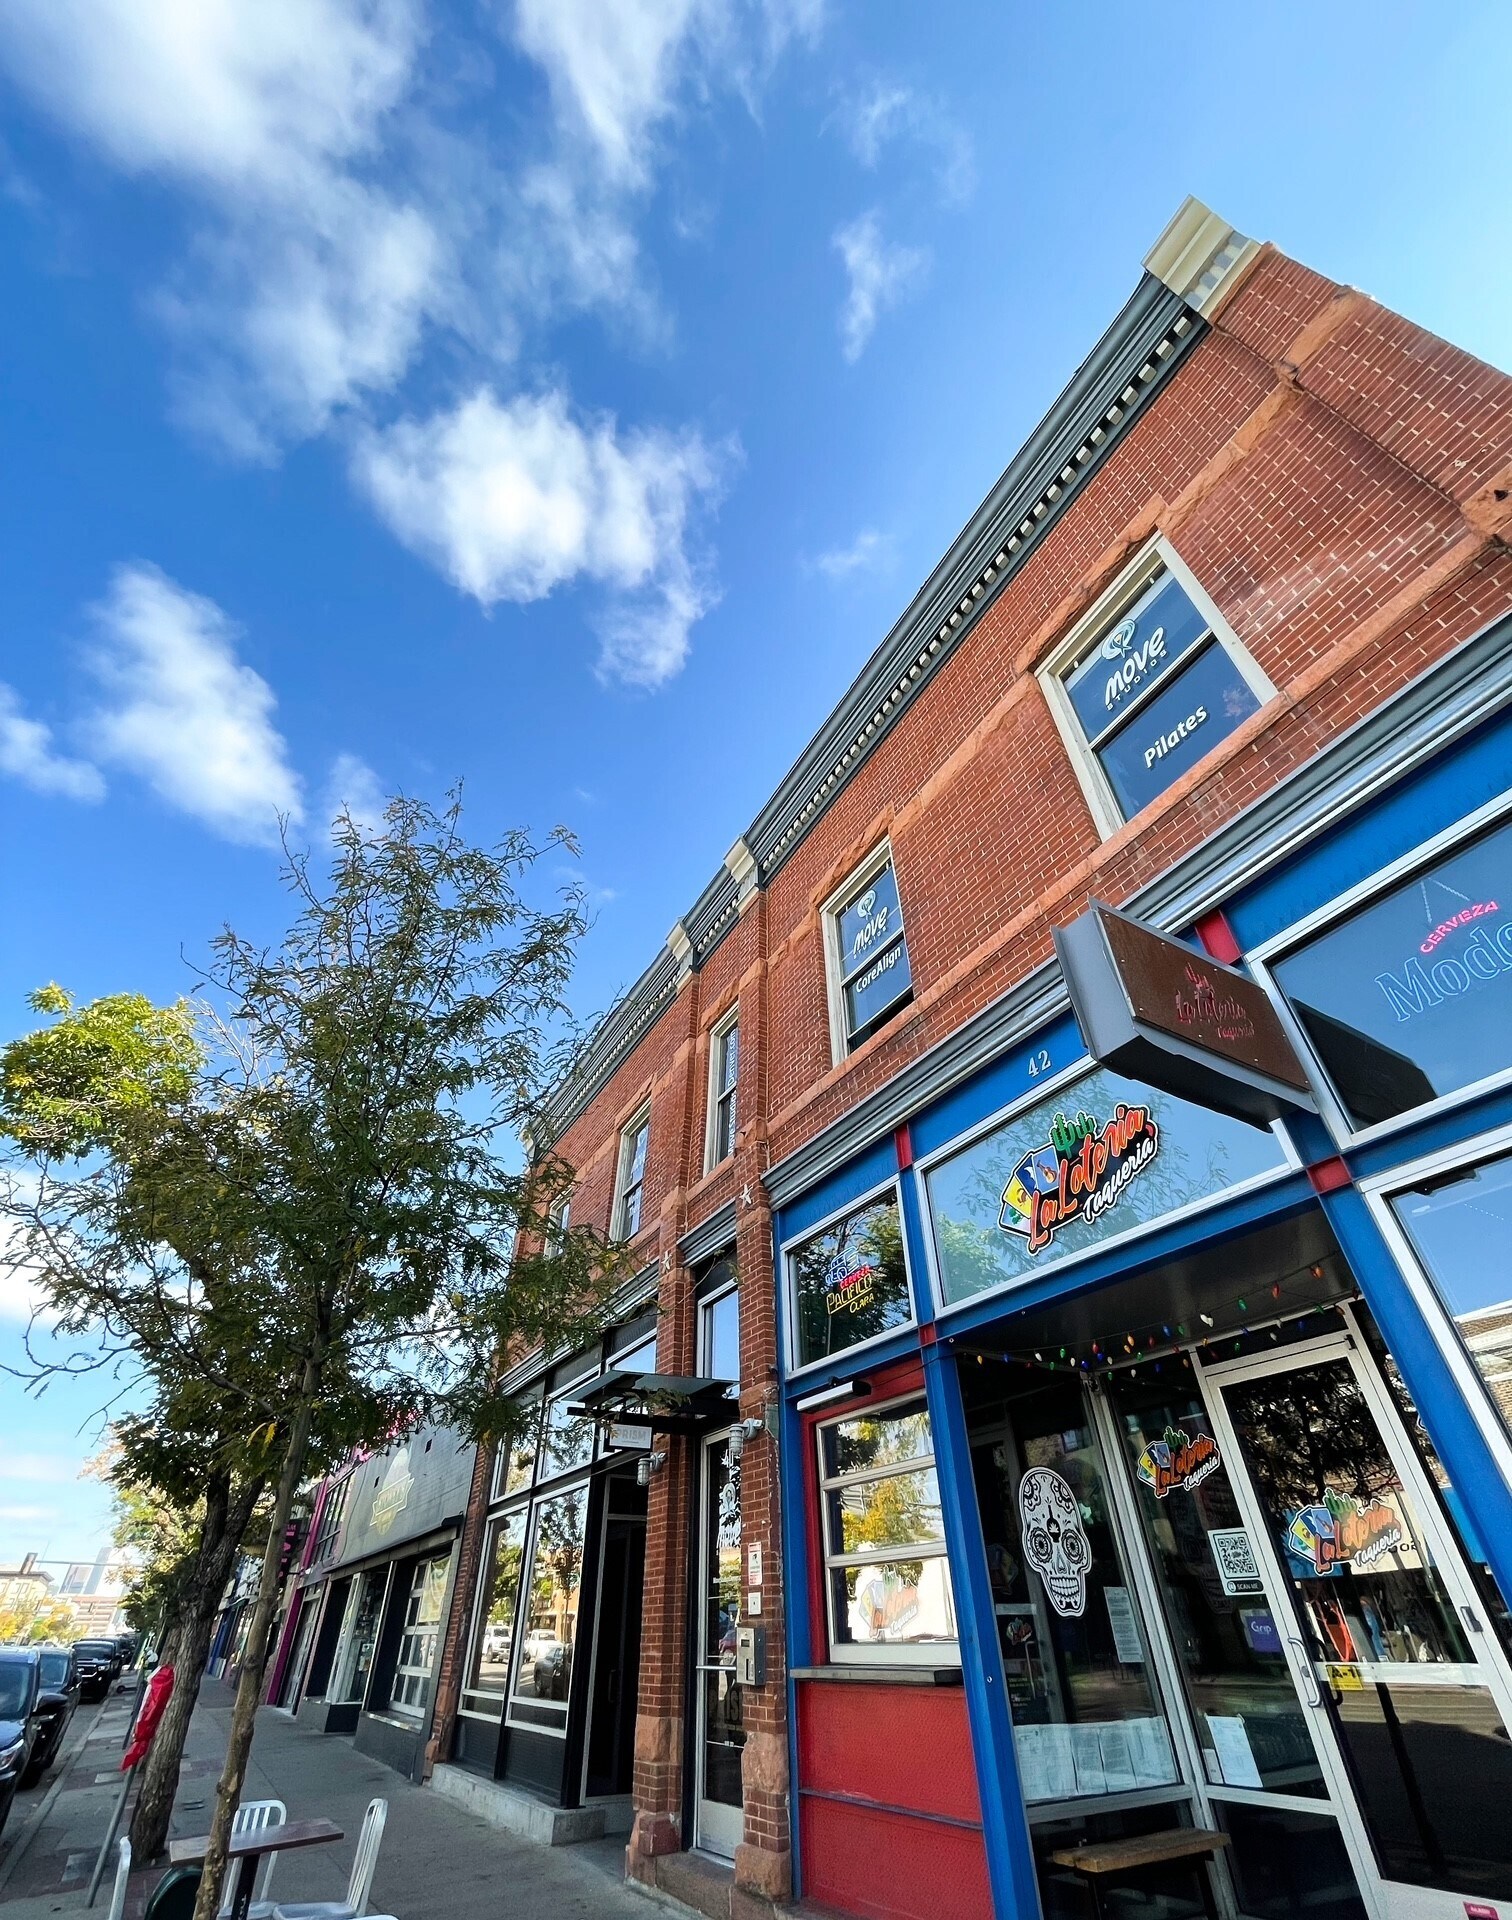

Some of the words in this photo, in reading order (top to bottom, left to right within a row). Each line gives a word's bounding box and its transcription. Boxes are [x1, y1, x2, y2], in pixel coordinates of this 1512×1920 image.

[1106, 649, 1168, 711] STUDIOS
[1144, 705, 1208, 769] Pilates
[1420, 900, 1500, 953] CERVEZA
[856, 946, 901, 993] CoreAlign
[1028, 1050, 1052, 1078] 42
[1030, 1190, 1058, 1250] La
[1057, 1107, 1146, 1219] Loteria
[1082, 1137, 1154, 1220] Taqueria
[826, 1273, 872, 1314] PACIFICO
[1155, 1464, 1171, 1496] La
[1184, 1456, 1218, 1488] Taqueria
[1315, 1533, 1336, 1573] La
[1354, 1528, 1401, 1567] Taqueria
